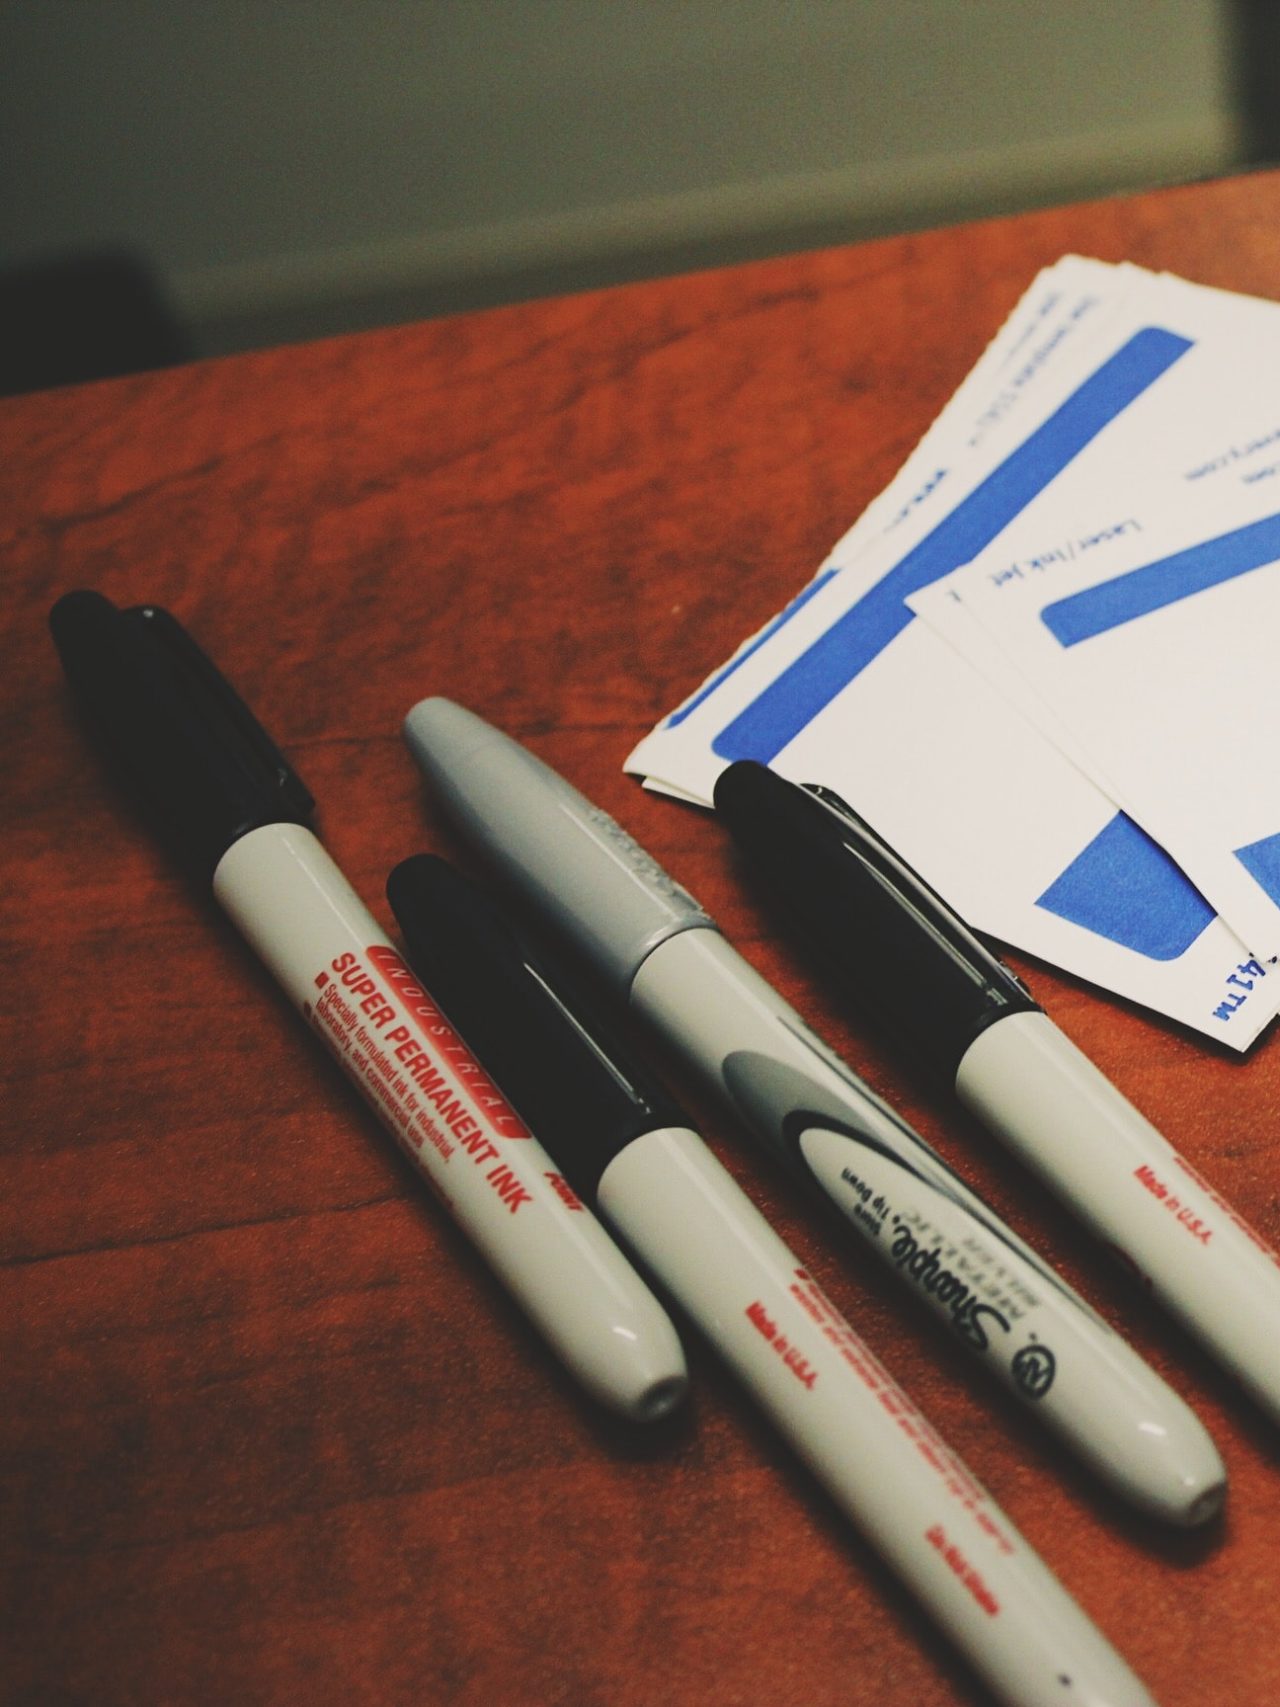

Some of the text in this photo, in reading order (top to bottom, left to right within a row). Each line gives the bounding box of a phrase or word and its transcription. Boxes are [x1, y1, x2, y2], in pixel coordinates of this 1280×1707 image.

[324, 984, 456, 1164] Specially formulated ink for industrial,
[331, 950, 397, 1030] SUPER
[383, 1023, 500, 1167] PERMANENT
[483, 1164, 533, 1215] INK
[377, 953, 518, 1125] INDUSTRIAL
[350, 1049, 371, 1072] and
[364, 1067, 412, 1128] commercial
[840, 1166, 892, 1220] Tip Down
[1132, 1164, 1171, 1200] Made
[1164, 1194, 1182, 1211] in
[903, 1211, 1025, 1322] METALLIC
[743, 1300, 781, 1341] Made
[771, 1335, 790, 1354] in
